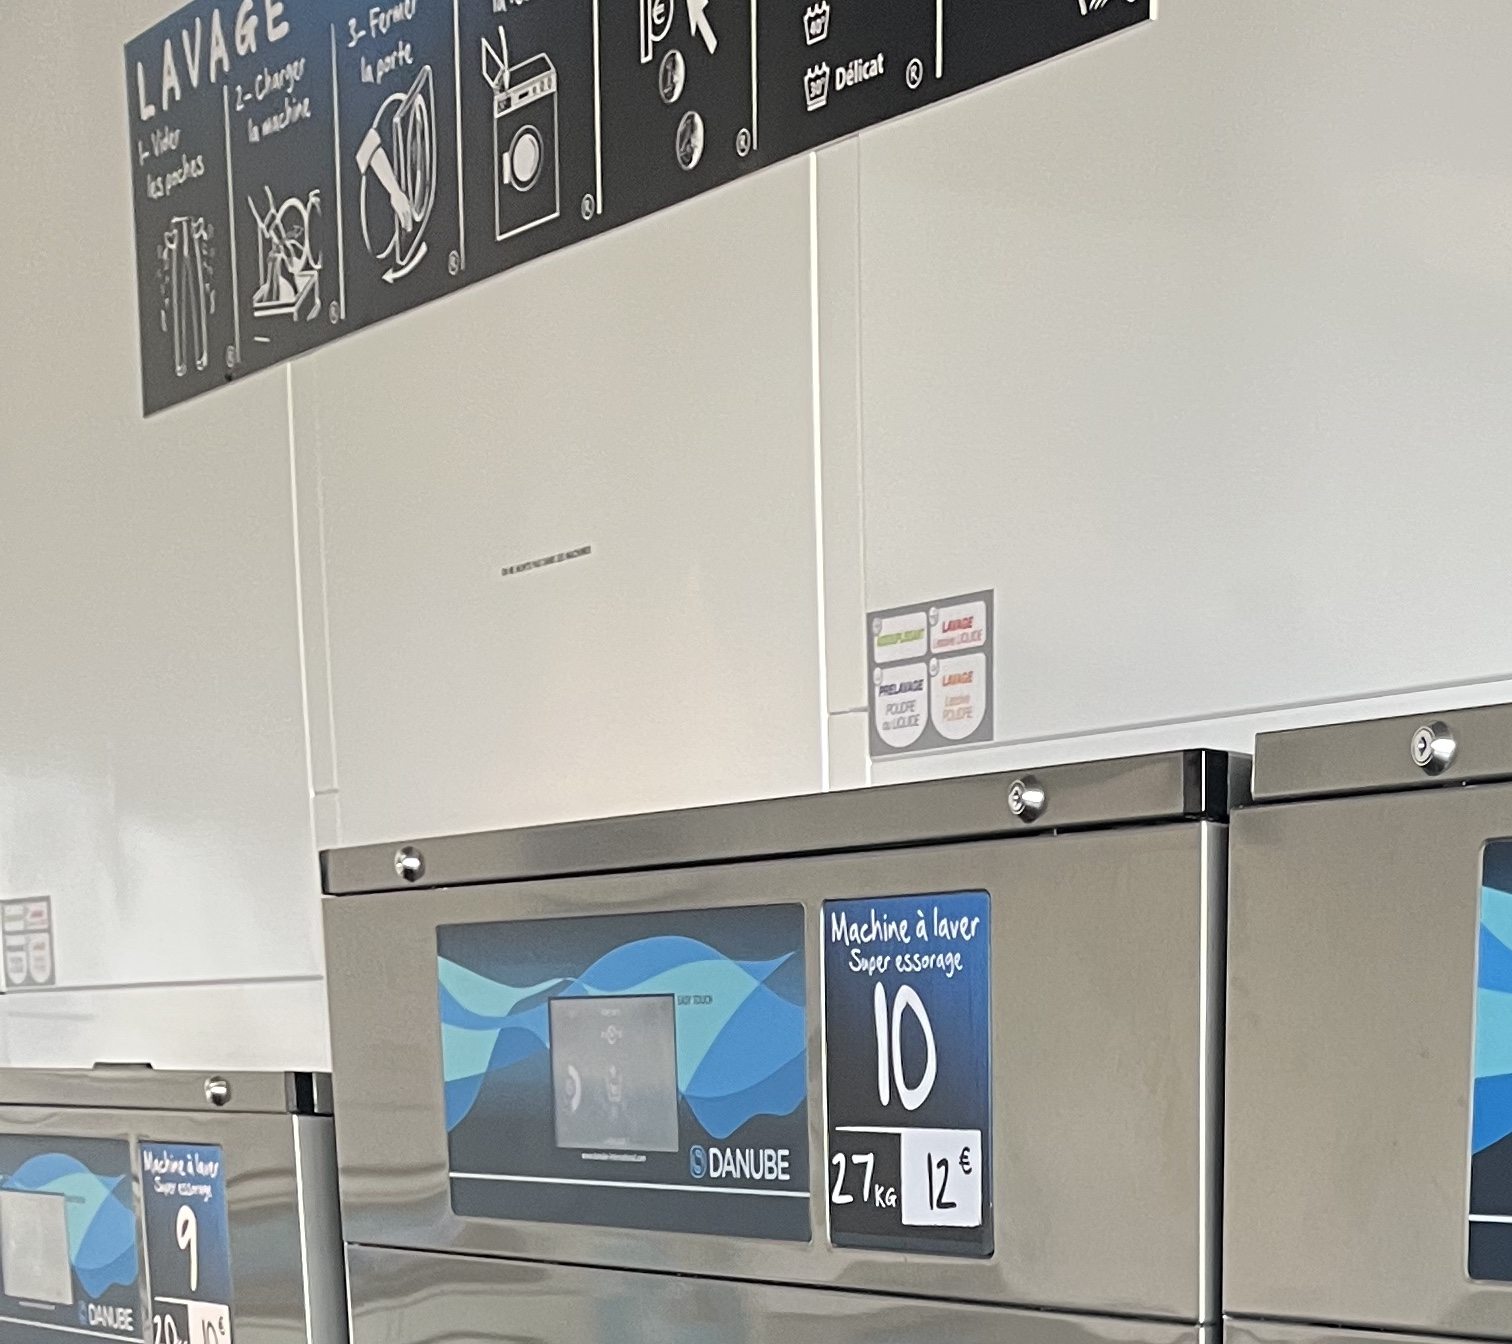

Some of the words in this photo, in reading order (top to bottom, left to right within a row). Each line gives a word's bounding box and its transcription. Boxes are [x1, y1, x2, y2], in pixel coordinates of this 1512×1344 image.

[137, 0, 290, 121] LAVAGE
[255, 57, 306, 101] Charger
[376, 40, 414, 85] porte
[835, 52, 884, 91] Délicat
[262, 96, 311, 137] machine
[165, 153, 205, 196] poches
[830, 909, 911, 946] Machine
[916, 909, 929, 944] à
[933, 906, 981, 944] laver
[848, 948, 891, 979] Super
[895, 949, 964, 979] essorage
[874, 981, 937, 1111] 10
[708, 1146, 791, 1182] DANUBE
[176, 1204, 199, 1293] 9
[88, 1302, 134, 1331] DANUBE
